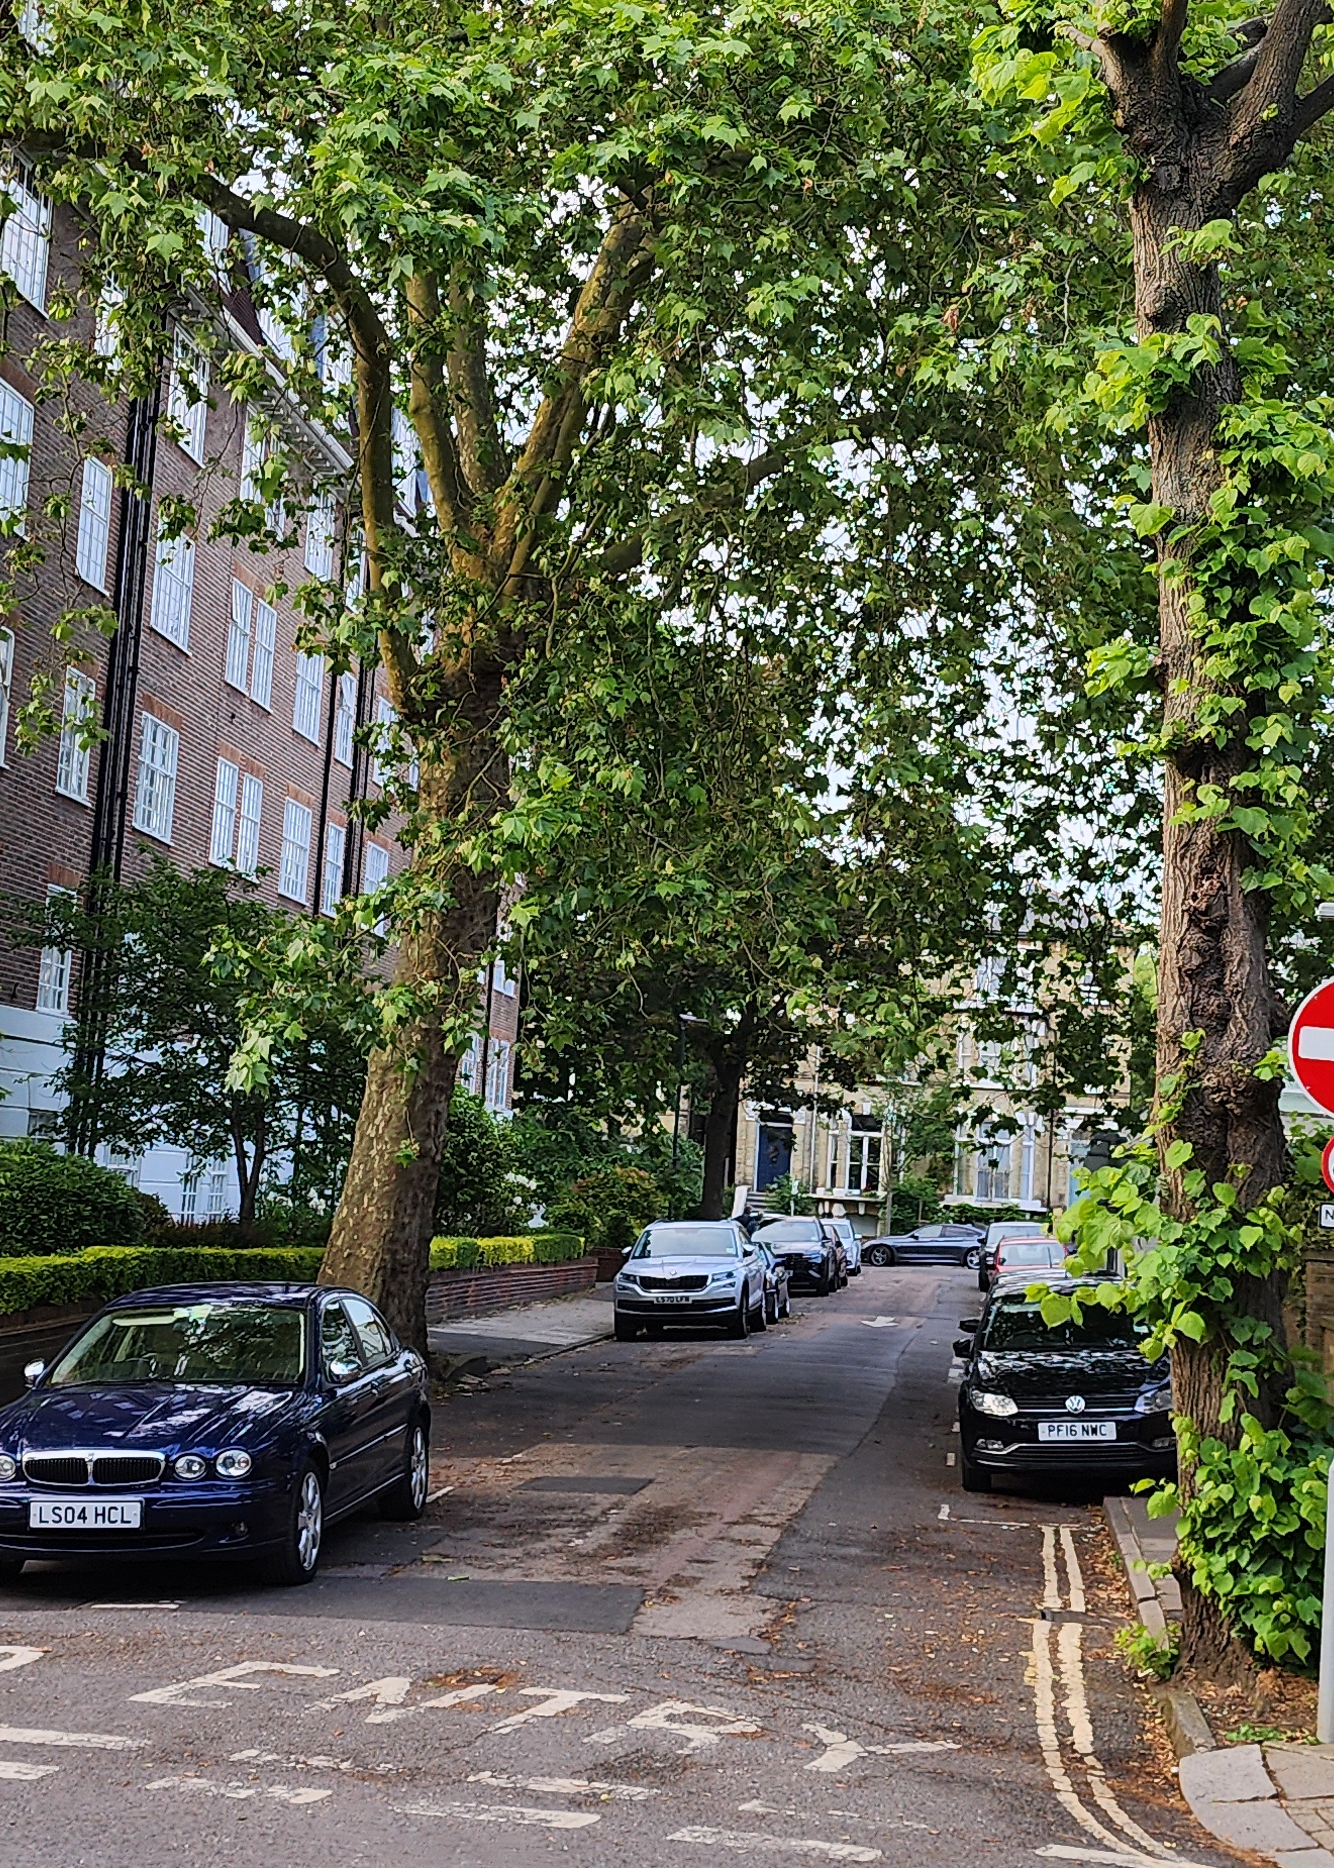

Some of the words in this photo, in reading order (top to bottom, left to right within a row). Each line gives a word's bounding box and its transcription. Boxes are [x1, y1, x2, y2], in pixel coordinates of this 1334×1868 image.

[1048, 1424, 1077, 1437] PF16
[1081, 1424, 1107, 1437] NWC
[39, 1506, 88, 1524] LS04
[94, 1506, 132, 1524] HCL
[129, 1660, 963, 1772] ENTRY
